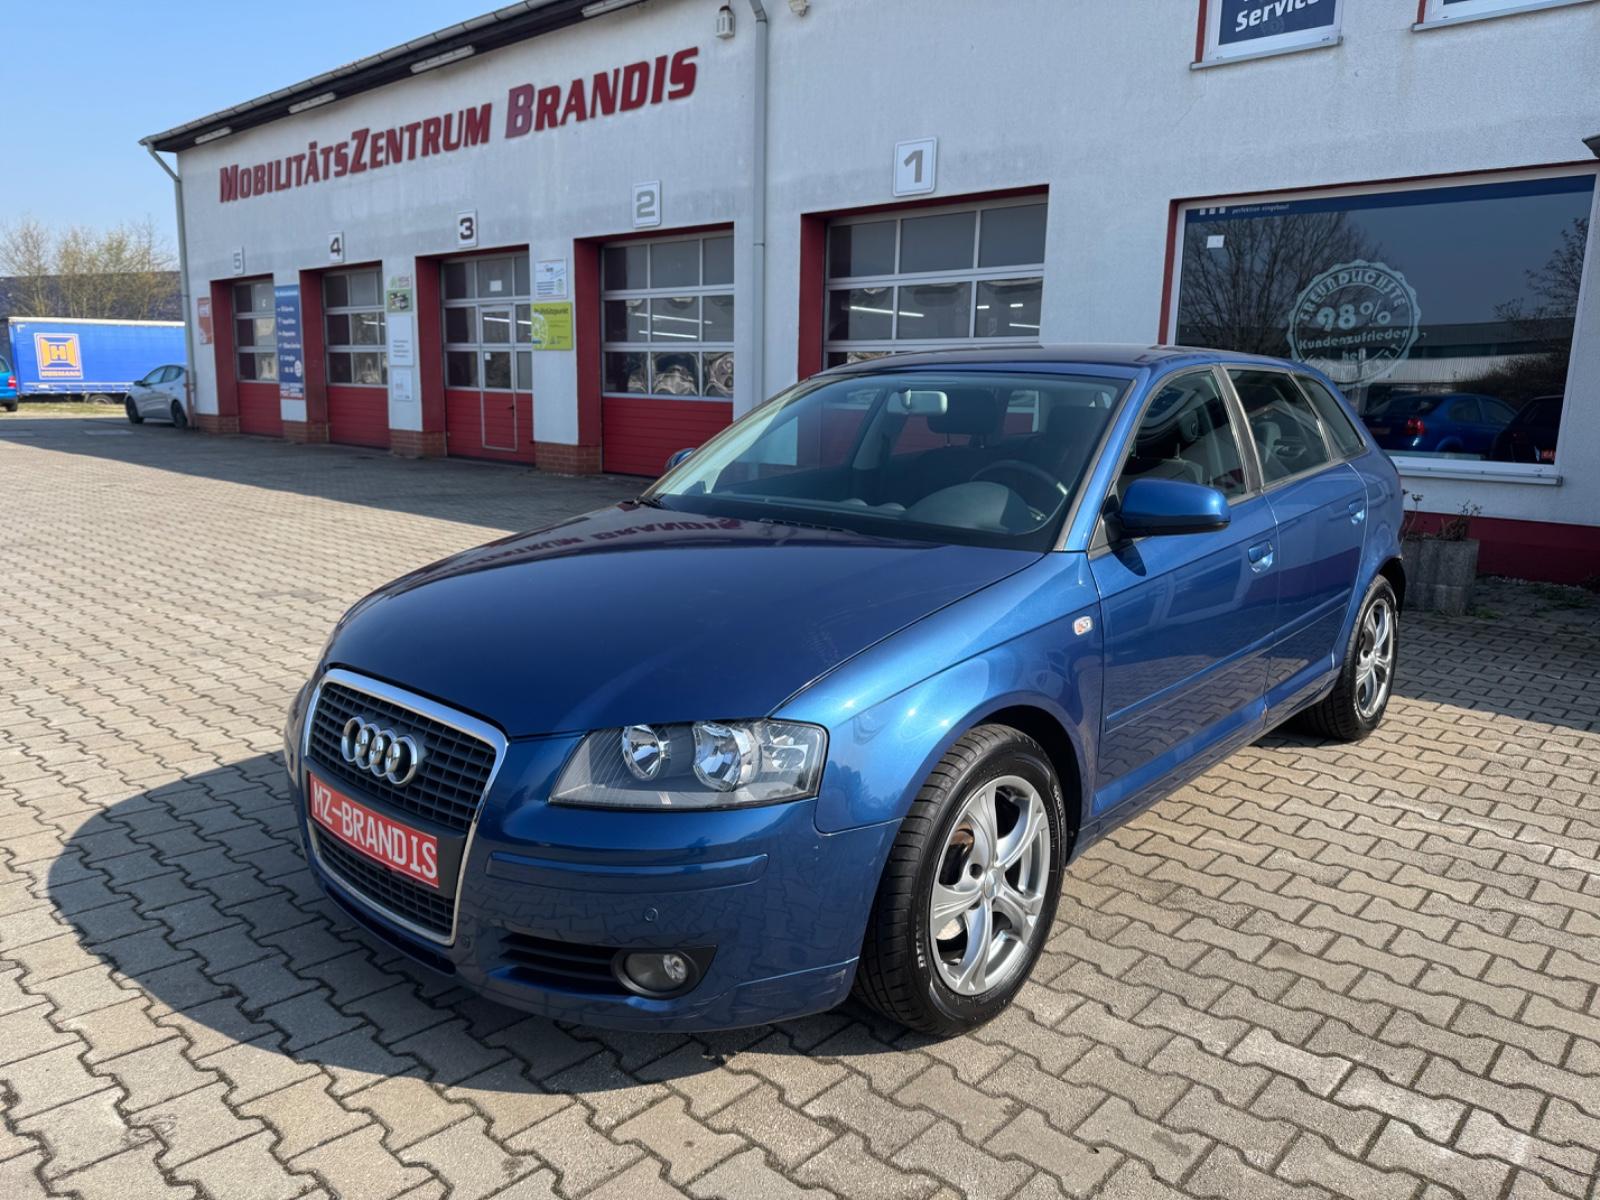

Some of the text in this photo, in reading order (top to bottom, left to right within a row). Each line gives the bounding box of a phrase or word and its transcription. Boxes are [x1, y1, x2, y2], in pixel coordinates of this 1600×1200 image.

[1235, 0, 1321, 32] Servic
[505, 47, 699, 139] BRANDIS
[904, 149, 923, 183] 1
[636, 190, 655, 218] 2
[459, 216, 474, 241] 3
[233, 252, 242, 270] 5
[330, 237, 342, 257] 4
[1317, 299, 1392, 333] 98%
[313, 780, 438, 879] MZ-BRANDIS
